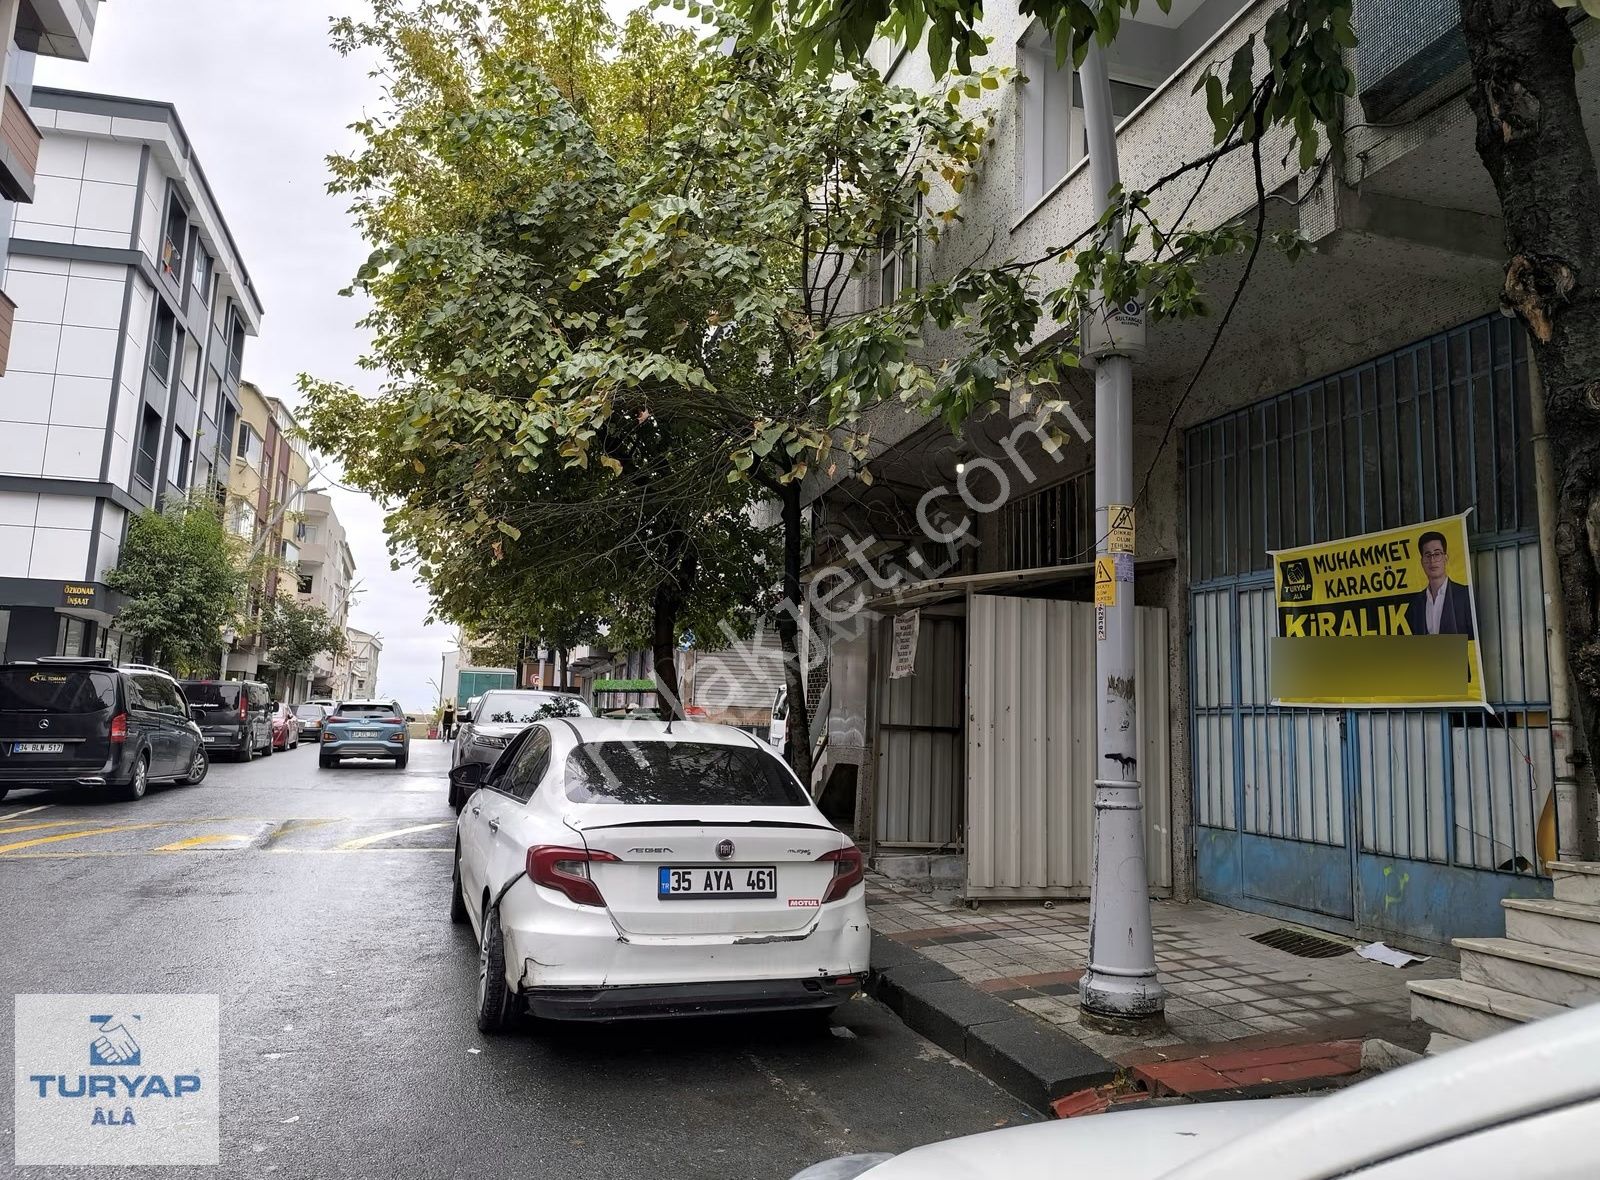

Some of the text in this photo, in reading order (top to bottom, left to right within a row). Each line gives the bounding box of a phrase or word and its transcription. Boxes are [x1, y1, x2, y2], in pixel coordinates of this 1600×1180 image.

[1313, 539, 1411, 574] MUHAMMET
[1325, 566, 1408, 599] KARAGÖZ
[64, 585, 95, 595] ÖZKONAK
[1284, 583, 1312, 593] TURYAP
[67, 596, 90, 606] İNŞAAT
[20, 743, 61, 751] 34 BLN 517
[661, 882, 670, 890] TR
[671, 870, 773, 892] 35 AYA 461
